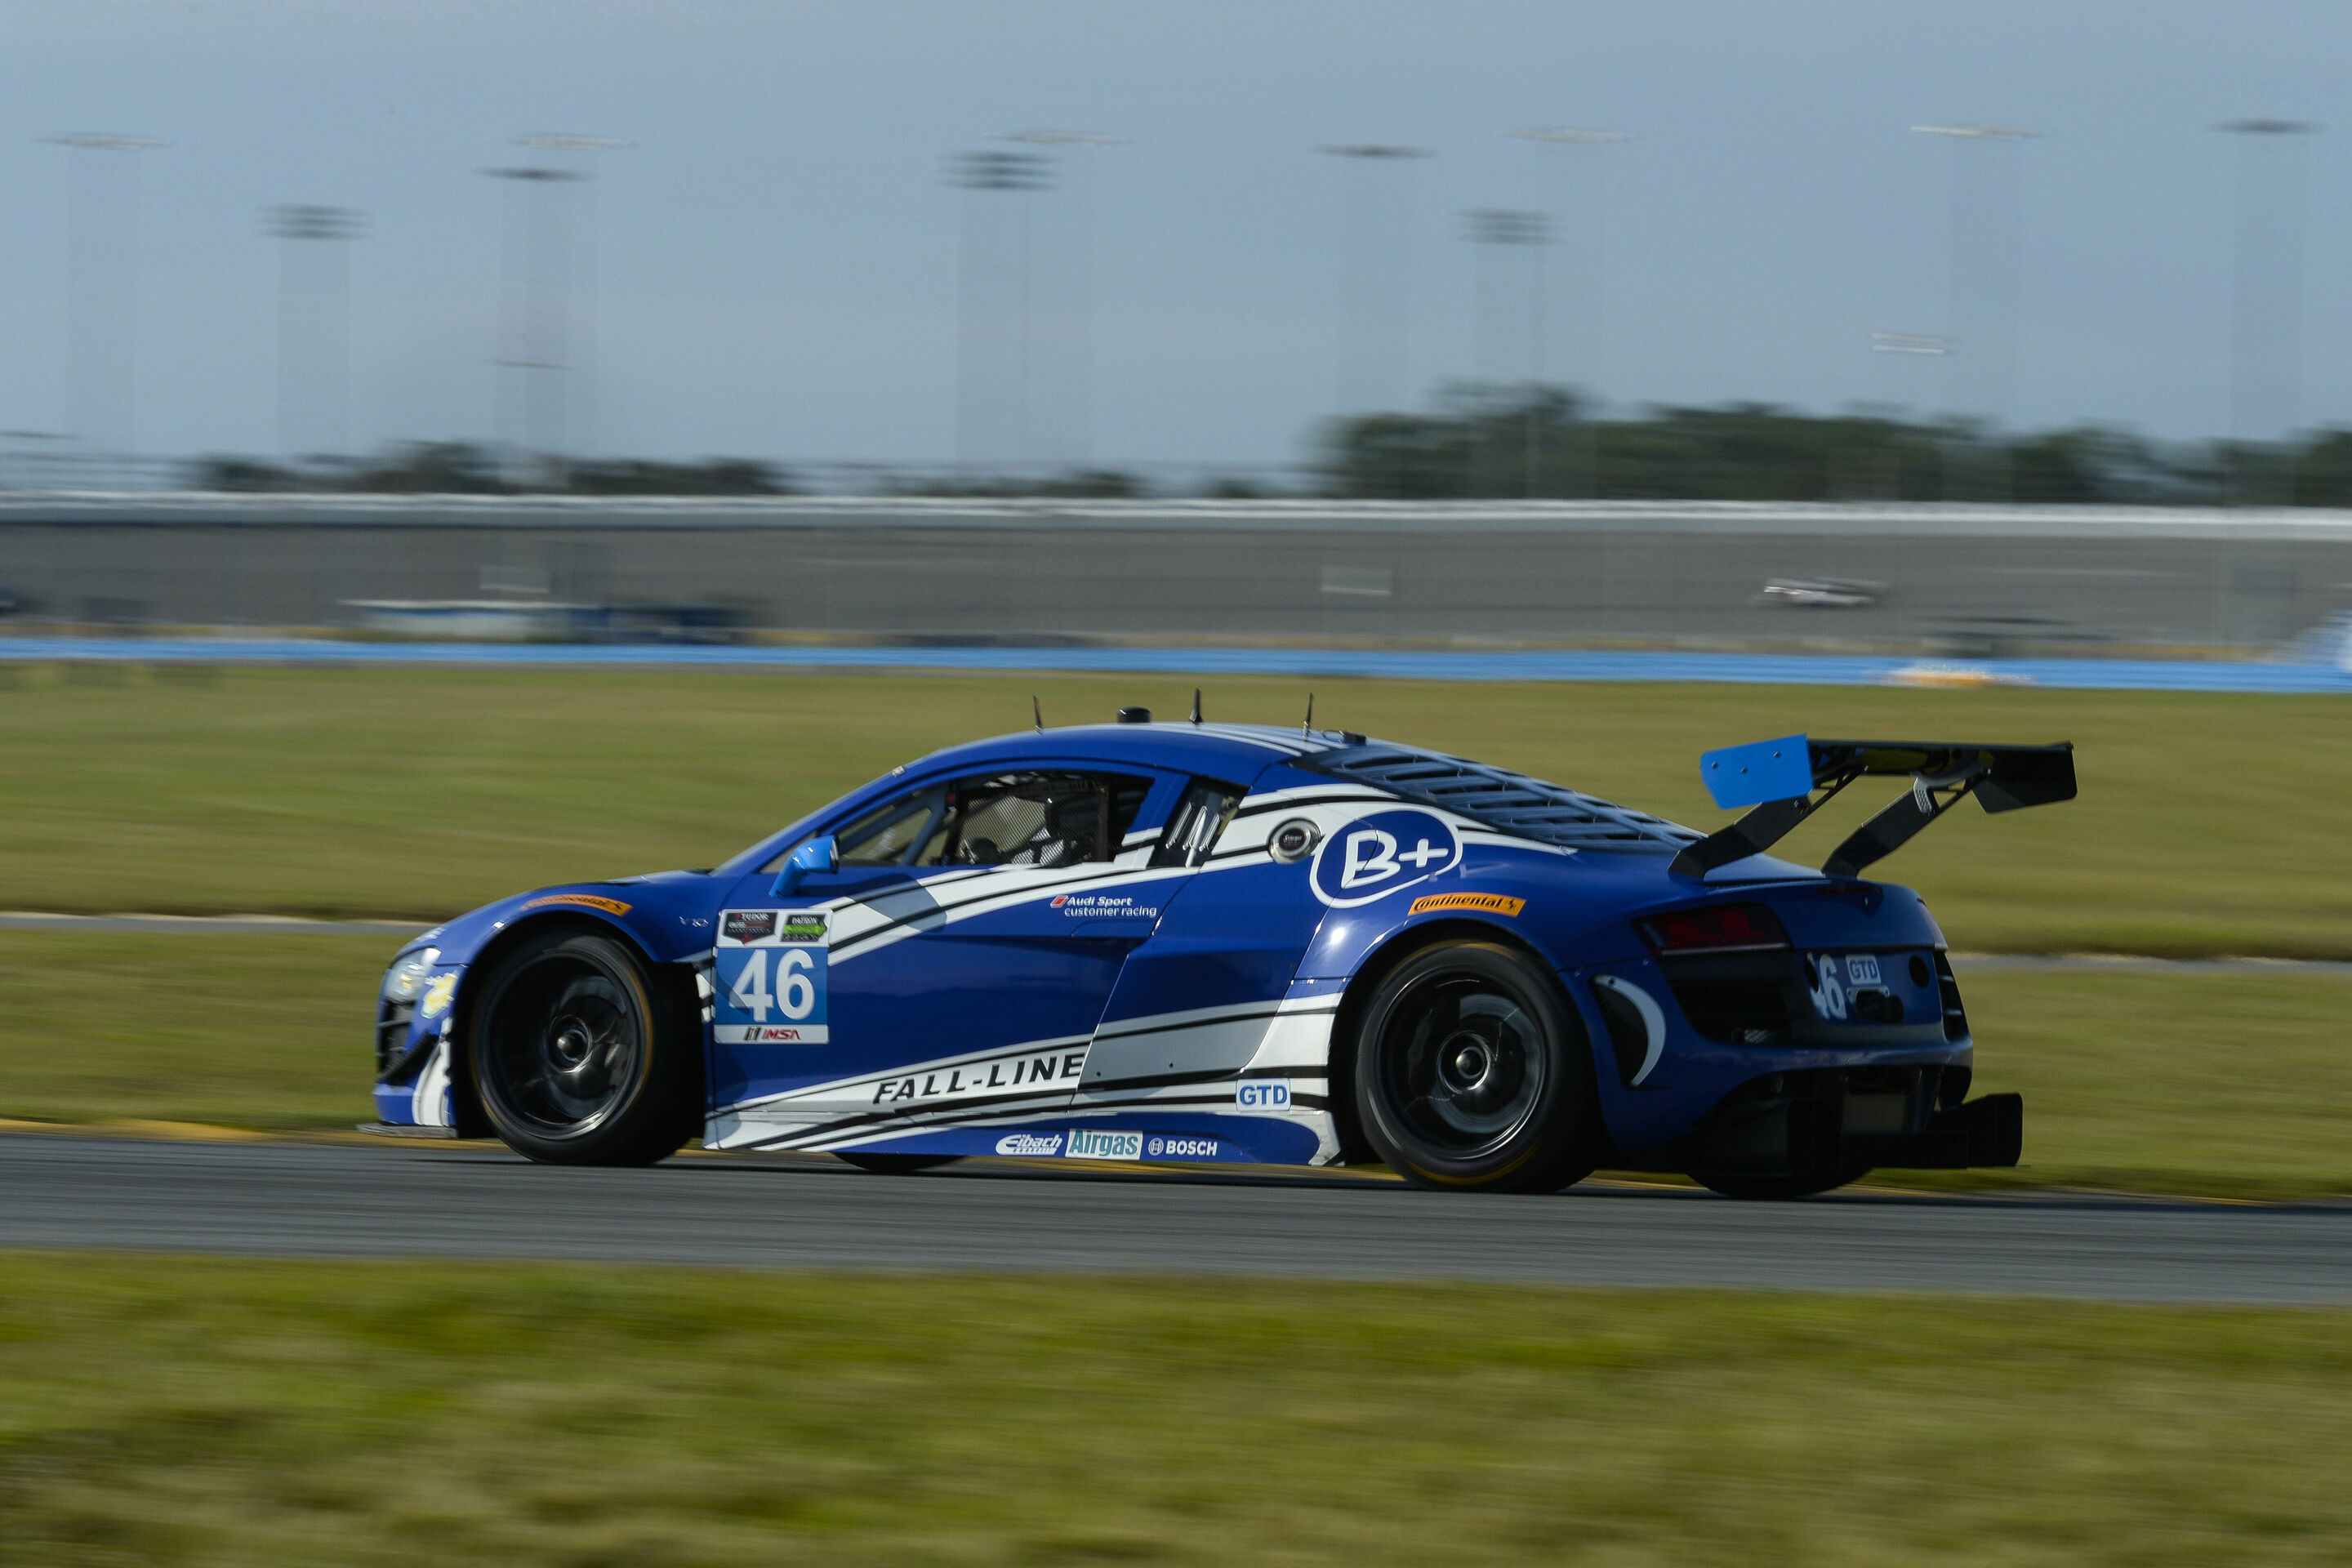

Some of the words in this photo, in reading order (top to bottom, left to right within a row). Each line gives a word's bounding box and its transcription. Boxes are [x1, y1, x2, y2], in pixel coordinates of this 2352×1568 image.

[1340, 829, 1449, 889] B+
[1067, 897, 1095, 906] Audi
[1098, 897, 1133, 907] Sport
[1414, 895, 1503, 912] Continental
[1064, 906, 1120, 917] customer
[1121, 906, 1157, 918] racing
[1848, 960, 1878, 979] GTD
[728, 948, 815, 1022] 46
[762, 1027, 801, 1040] IMSA
[872, 1052, 1085, 1104] FALL-LINE
[1239, 1085, 1288, 1105] GTD
[1068, 1130, 1138, 1158] Airgas
[1165, 1140, 1218, 1156] BOSCH
